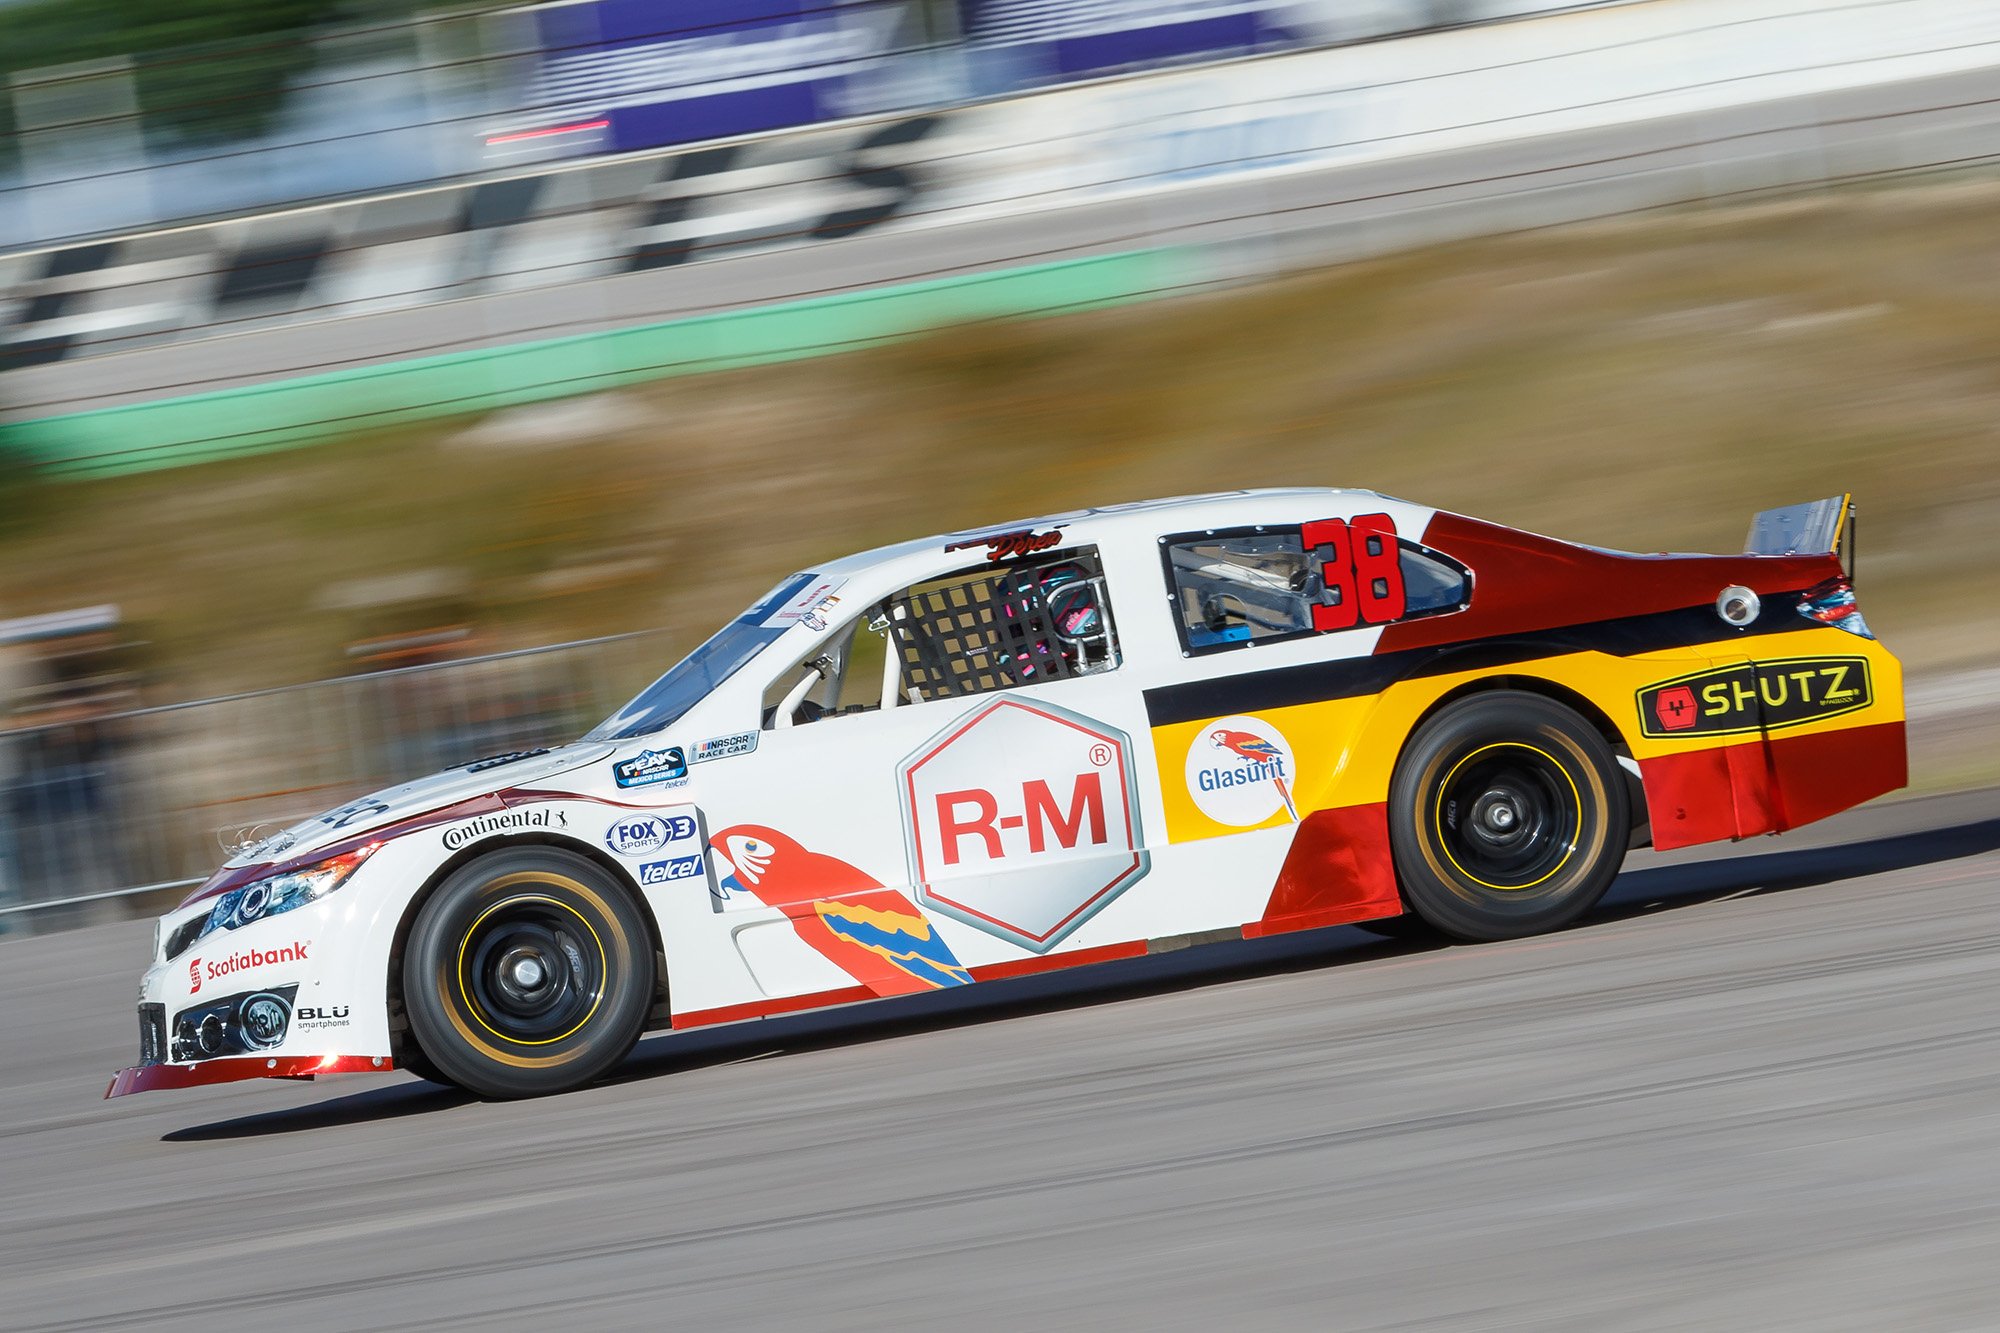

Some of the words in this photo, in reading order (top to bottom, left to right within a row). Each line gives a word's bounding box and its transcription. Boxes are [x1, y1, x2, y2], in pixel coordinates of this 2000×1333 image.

[1301, 512, 1407, 631] 38
[1702, 665, 1853, 716] SHUTZ
[698, 745, 724, 759] RACE
[727, 744, 748, 754] CAR
[710, 734, 749, 749] NASCAR
[621, 751, 679, 776] PEAK
[653, 769, 677, 780] SERIES
[442, 808, 550, 850] Continental
[618, 819, 656, 843] FOX
[674, 818, 690, 838] 3
[935, 772, 1108, 866] R-M
[620, 836, 660, 850] SPORTS
[641, 854, 701, 884] telcel
[207, 941, 308, 980] Scotiabank
[297, 1019, 350, 1029] smartphones
